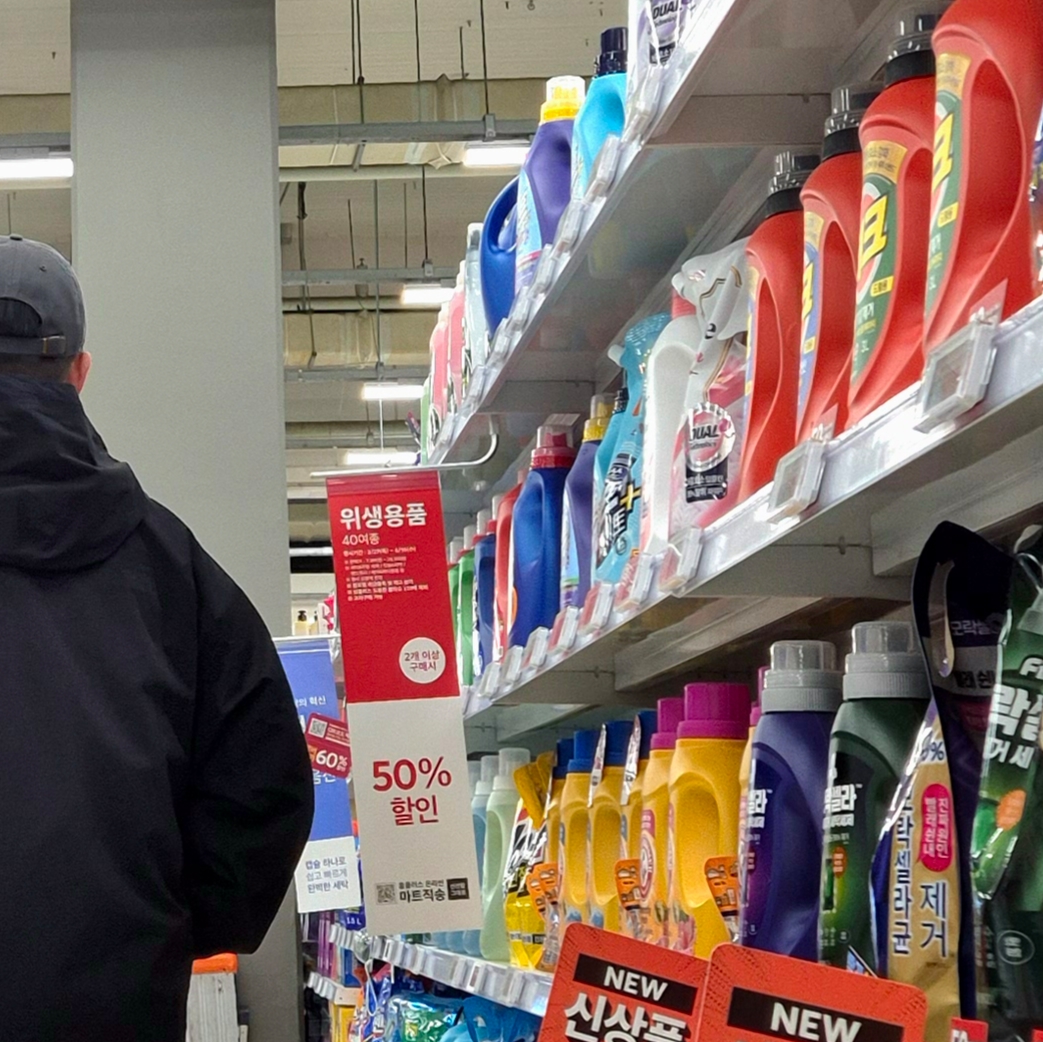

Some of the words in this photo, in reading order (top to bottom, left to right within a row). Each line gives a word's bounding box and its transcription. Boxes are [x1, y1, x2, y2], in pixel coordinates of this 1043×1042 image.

[340, 503, 428, 531] 위생용품
[342, 533, 380, 546] 40여종
[404, 651, 420, 662] 2개
[422, 650, 440, 660] 이상
[410, 661, 437, 672] 구매시
[373, 756, 452, 792] 50%
[390, 795, 439, 826] 할인
[323, 856, 347, 867] 하나로
[399, 888, 447, 904] 마트직송
[919, 880, 948, 958] 제거
[603, 965, 669, 1001] NEW
